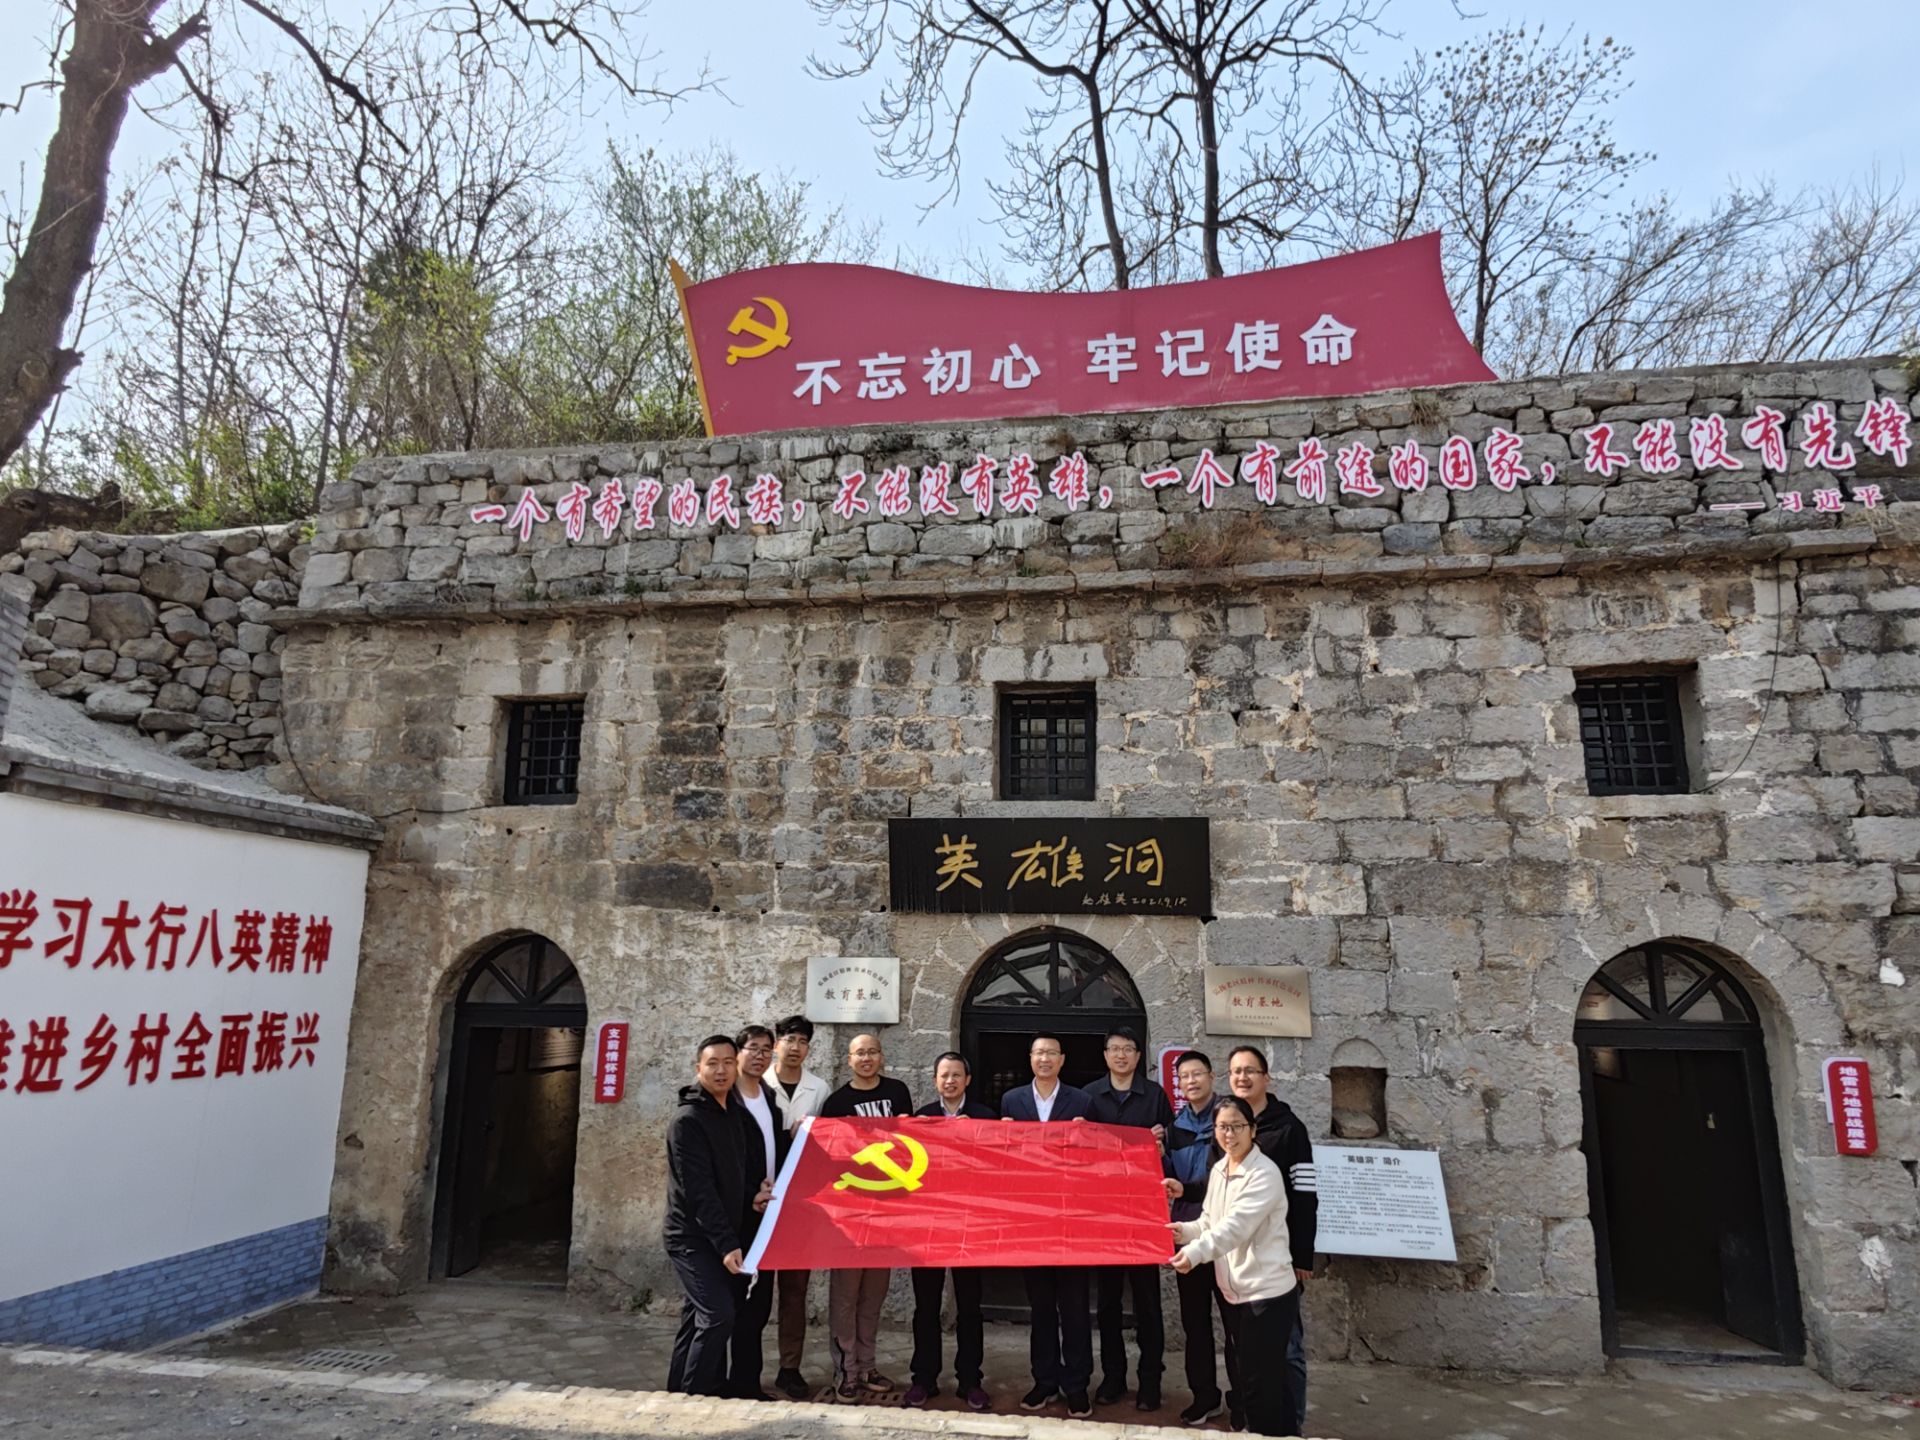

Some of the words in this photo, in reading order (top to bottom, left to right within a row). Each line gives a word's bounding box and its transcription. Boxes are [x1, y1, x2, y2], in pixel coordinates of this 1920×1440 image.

[793, 342, 1040, 405] 不忘初心
[1086, 313, 1357, 384] 牢记使命
[934, 833, 1165, 890] 英雄洞
[0, 889, 333, 974] 学习太行八英精神
[824, 987, 882, 1001] 教育基地
[1233, 995, 1283, 1009] 教育基地
[853, 1099, 894, 1117] NIKE
